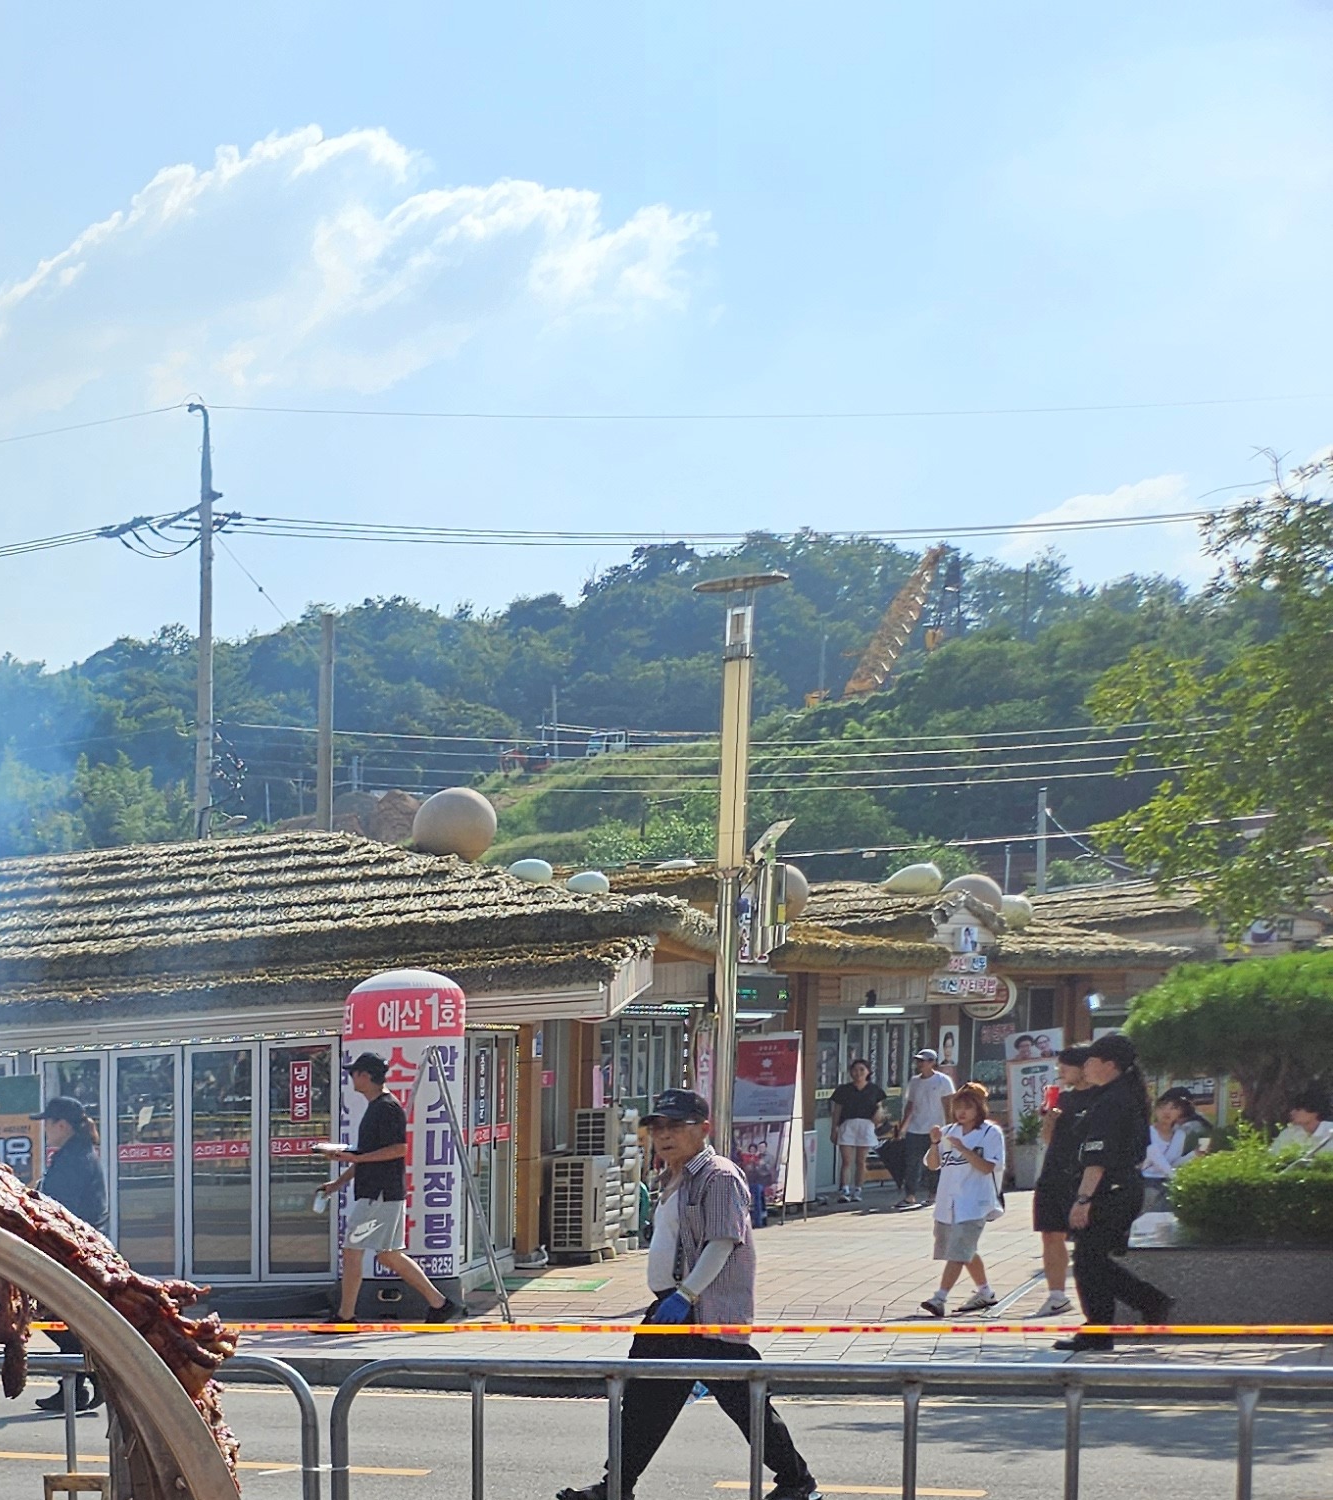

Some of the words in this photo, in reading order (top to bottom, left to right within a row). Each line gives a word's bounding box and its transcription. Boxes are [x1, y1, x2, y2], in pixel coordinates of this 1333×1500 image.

[293, 1065, 309, 1118] 냉방중
[194, 1144, 226, 1156] 소머리
[271, 1140, 292, 1153] 암소
